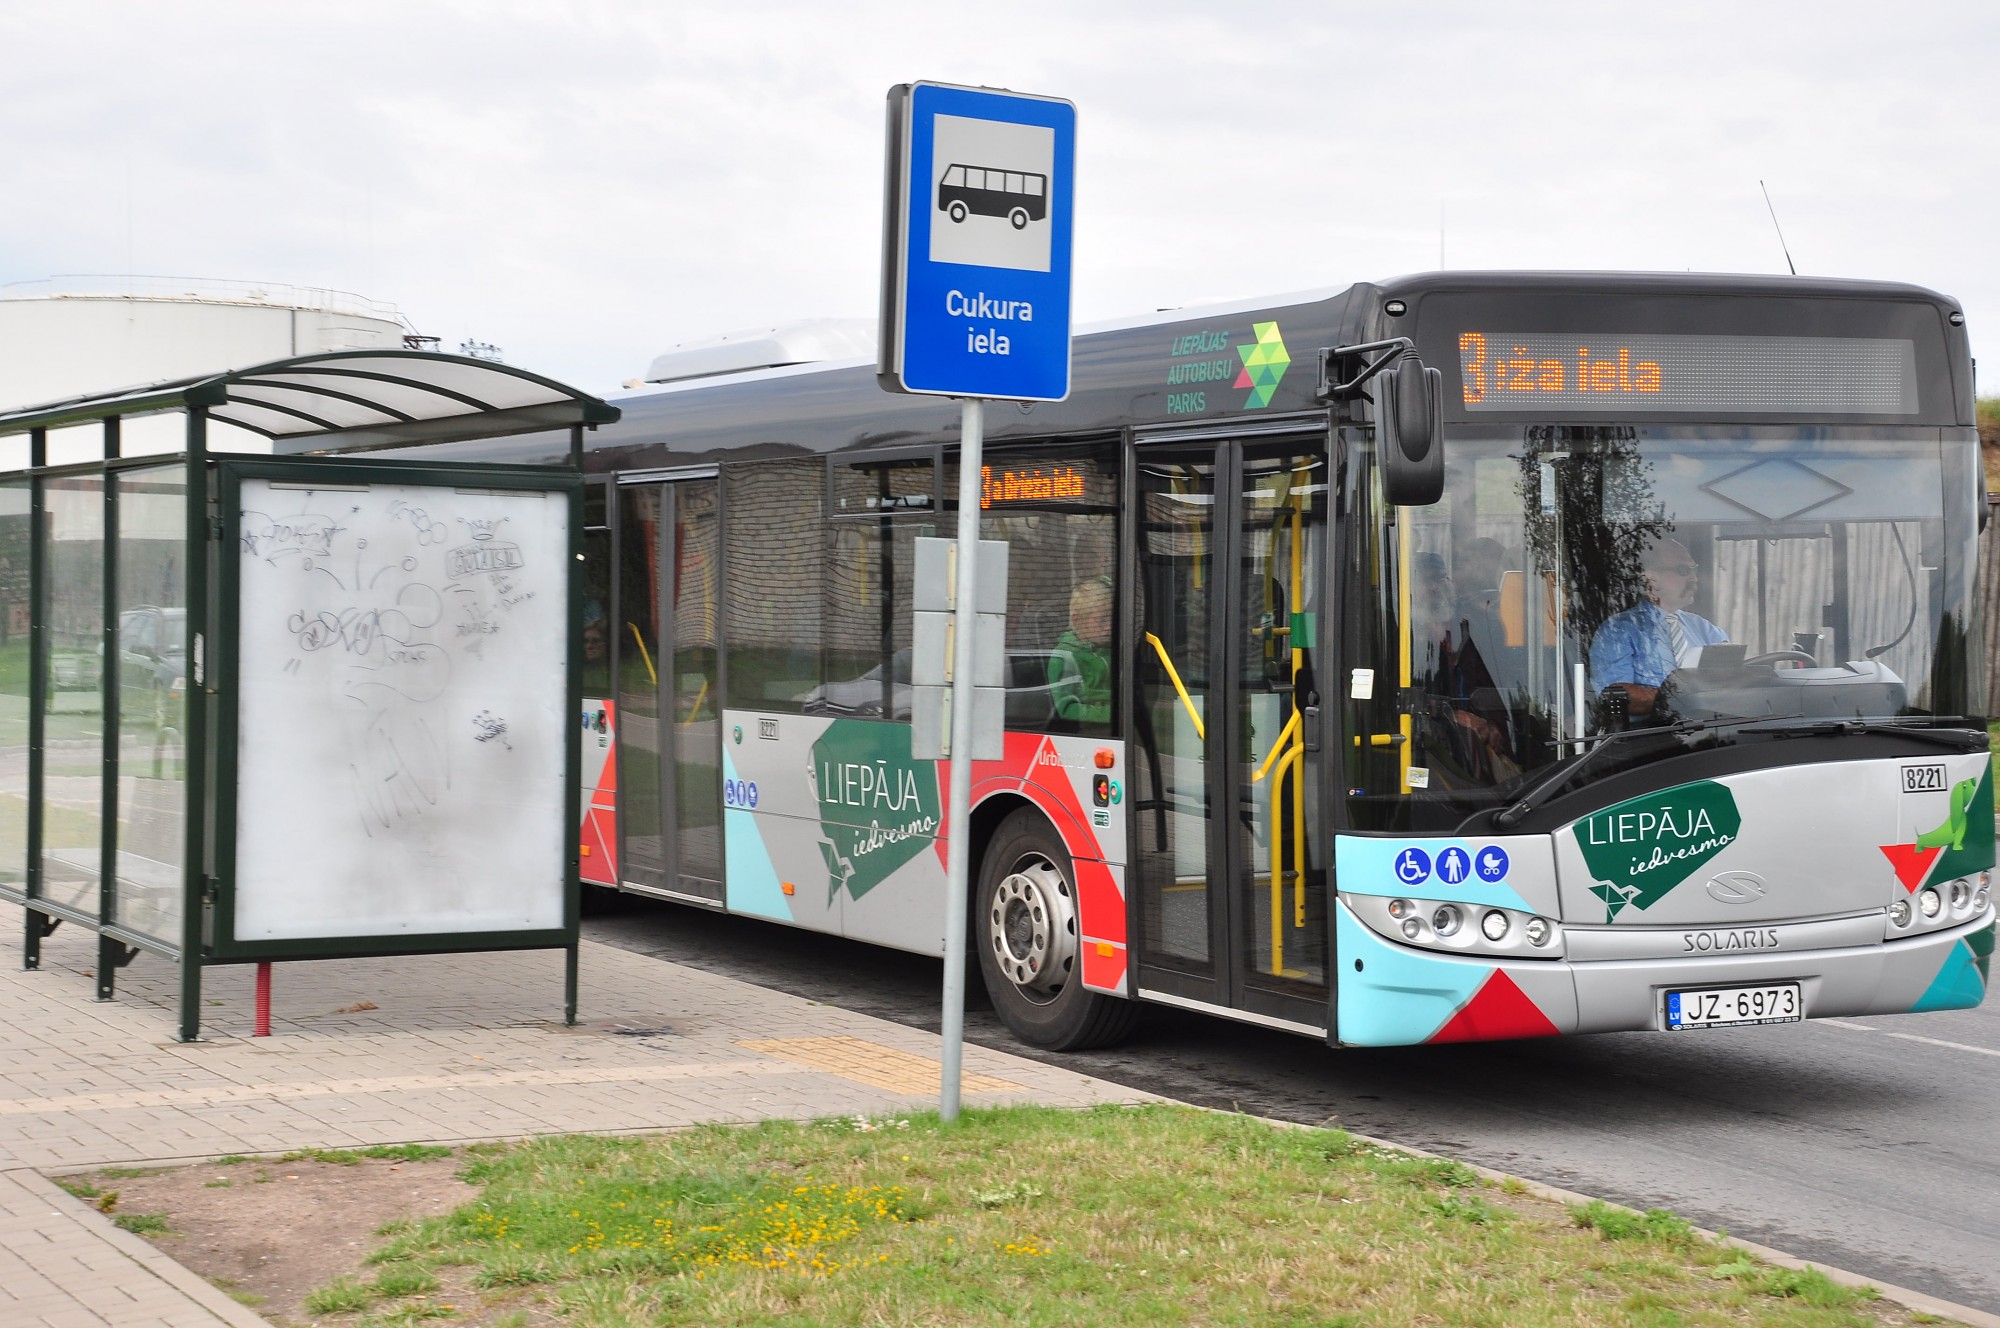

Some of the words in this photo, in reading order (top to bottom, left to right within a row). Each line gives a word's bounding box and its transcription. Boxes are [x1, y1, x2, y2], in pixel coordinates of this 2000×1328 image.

[945, 289, 1033, 322] Cukura
[967, 327, 1010, 355] iela
[1171, 330, 1230, 356] LIEPĀJAS
[1167, 360, 1232, 385] AUTOBUSU
[1577, 347, 1661, 392] iela
[1167, 392, 1206, 414] PARKS
[1053, 466, 1084, 497] iela
[824, 759, 921, 813] LIEPĀJA
[1906, 767, 1942, 790] 8221
[853, 815, 938, 857] iedvesmo
[1588, 806, 1716, 846] LIEPĀJA
[1629, 835, 1735, 876] iedvesmo
[1683, 928, 1780, 952] SOLARIS
[1669, 1012, 1680, 1020] LV
[1687, 989, 1795, 1020] JZ-6973
